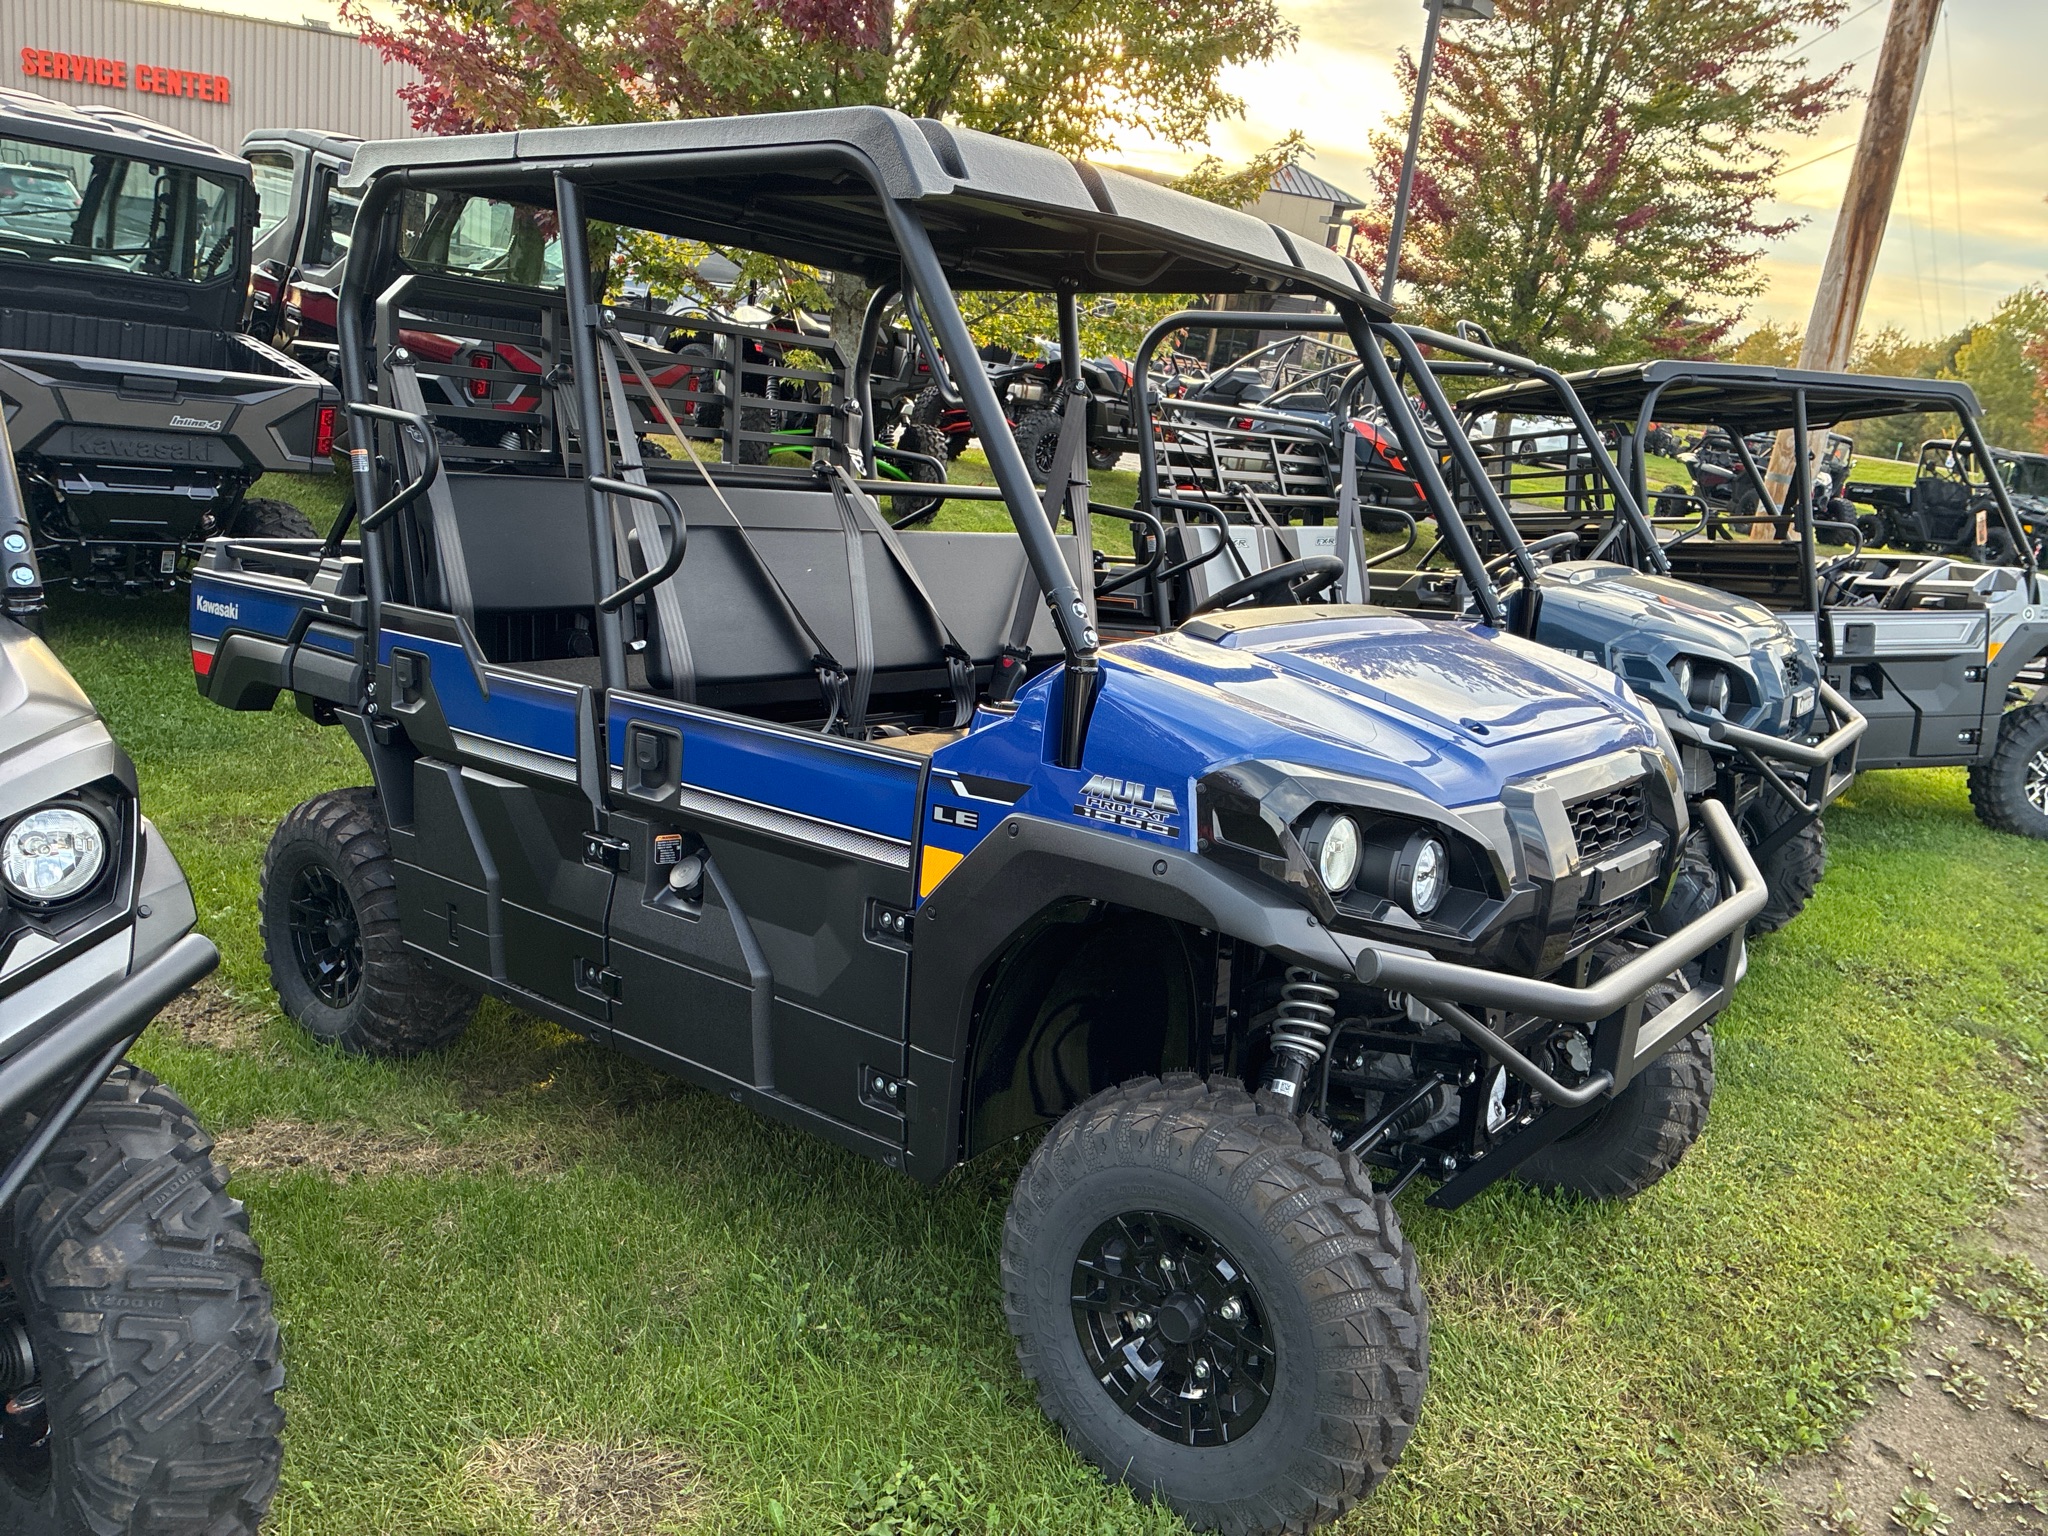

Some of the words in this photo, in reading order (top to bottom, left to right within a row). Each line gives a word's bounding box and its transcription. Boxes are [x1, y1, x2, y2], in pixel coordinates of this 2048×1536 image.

[21, 47, 127, 89] SERVICE
[134, 63, 230, 104] CENTER
[169, 415, 223, 431] Inline-4
[70, 430, 214, 463] Kawasaki
[196, 595, 239, 620] Kawasaki
[1078, 774, 1180, 816] MULE
[933, 805, 978, 829] LE
[1082, 807, 1170, 835] 1000
[1085, 796, 1170, 823] PRO-FXT
